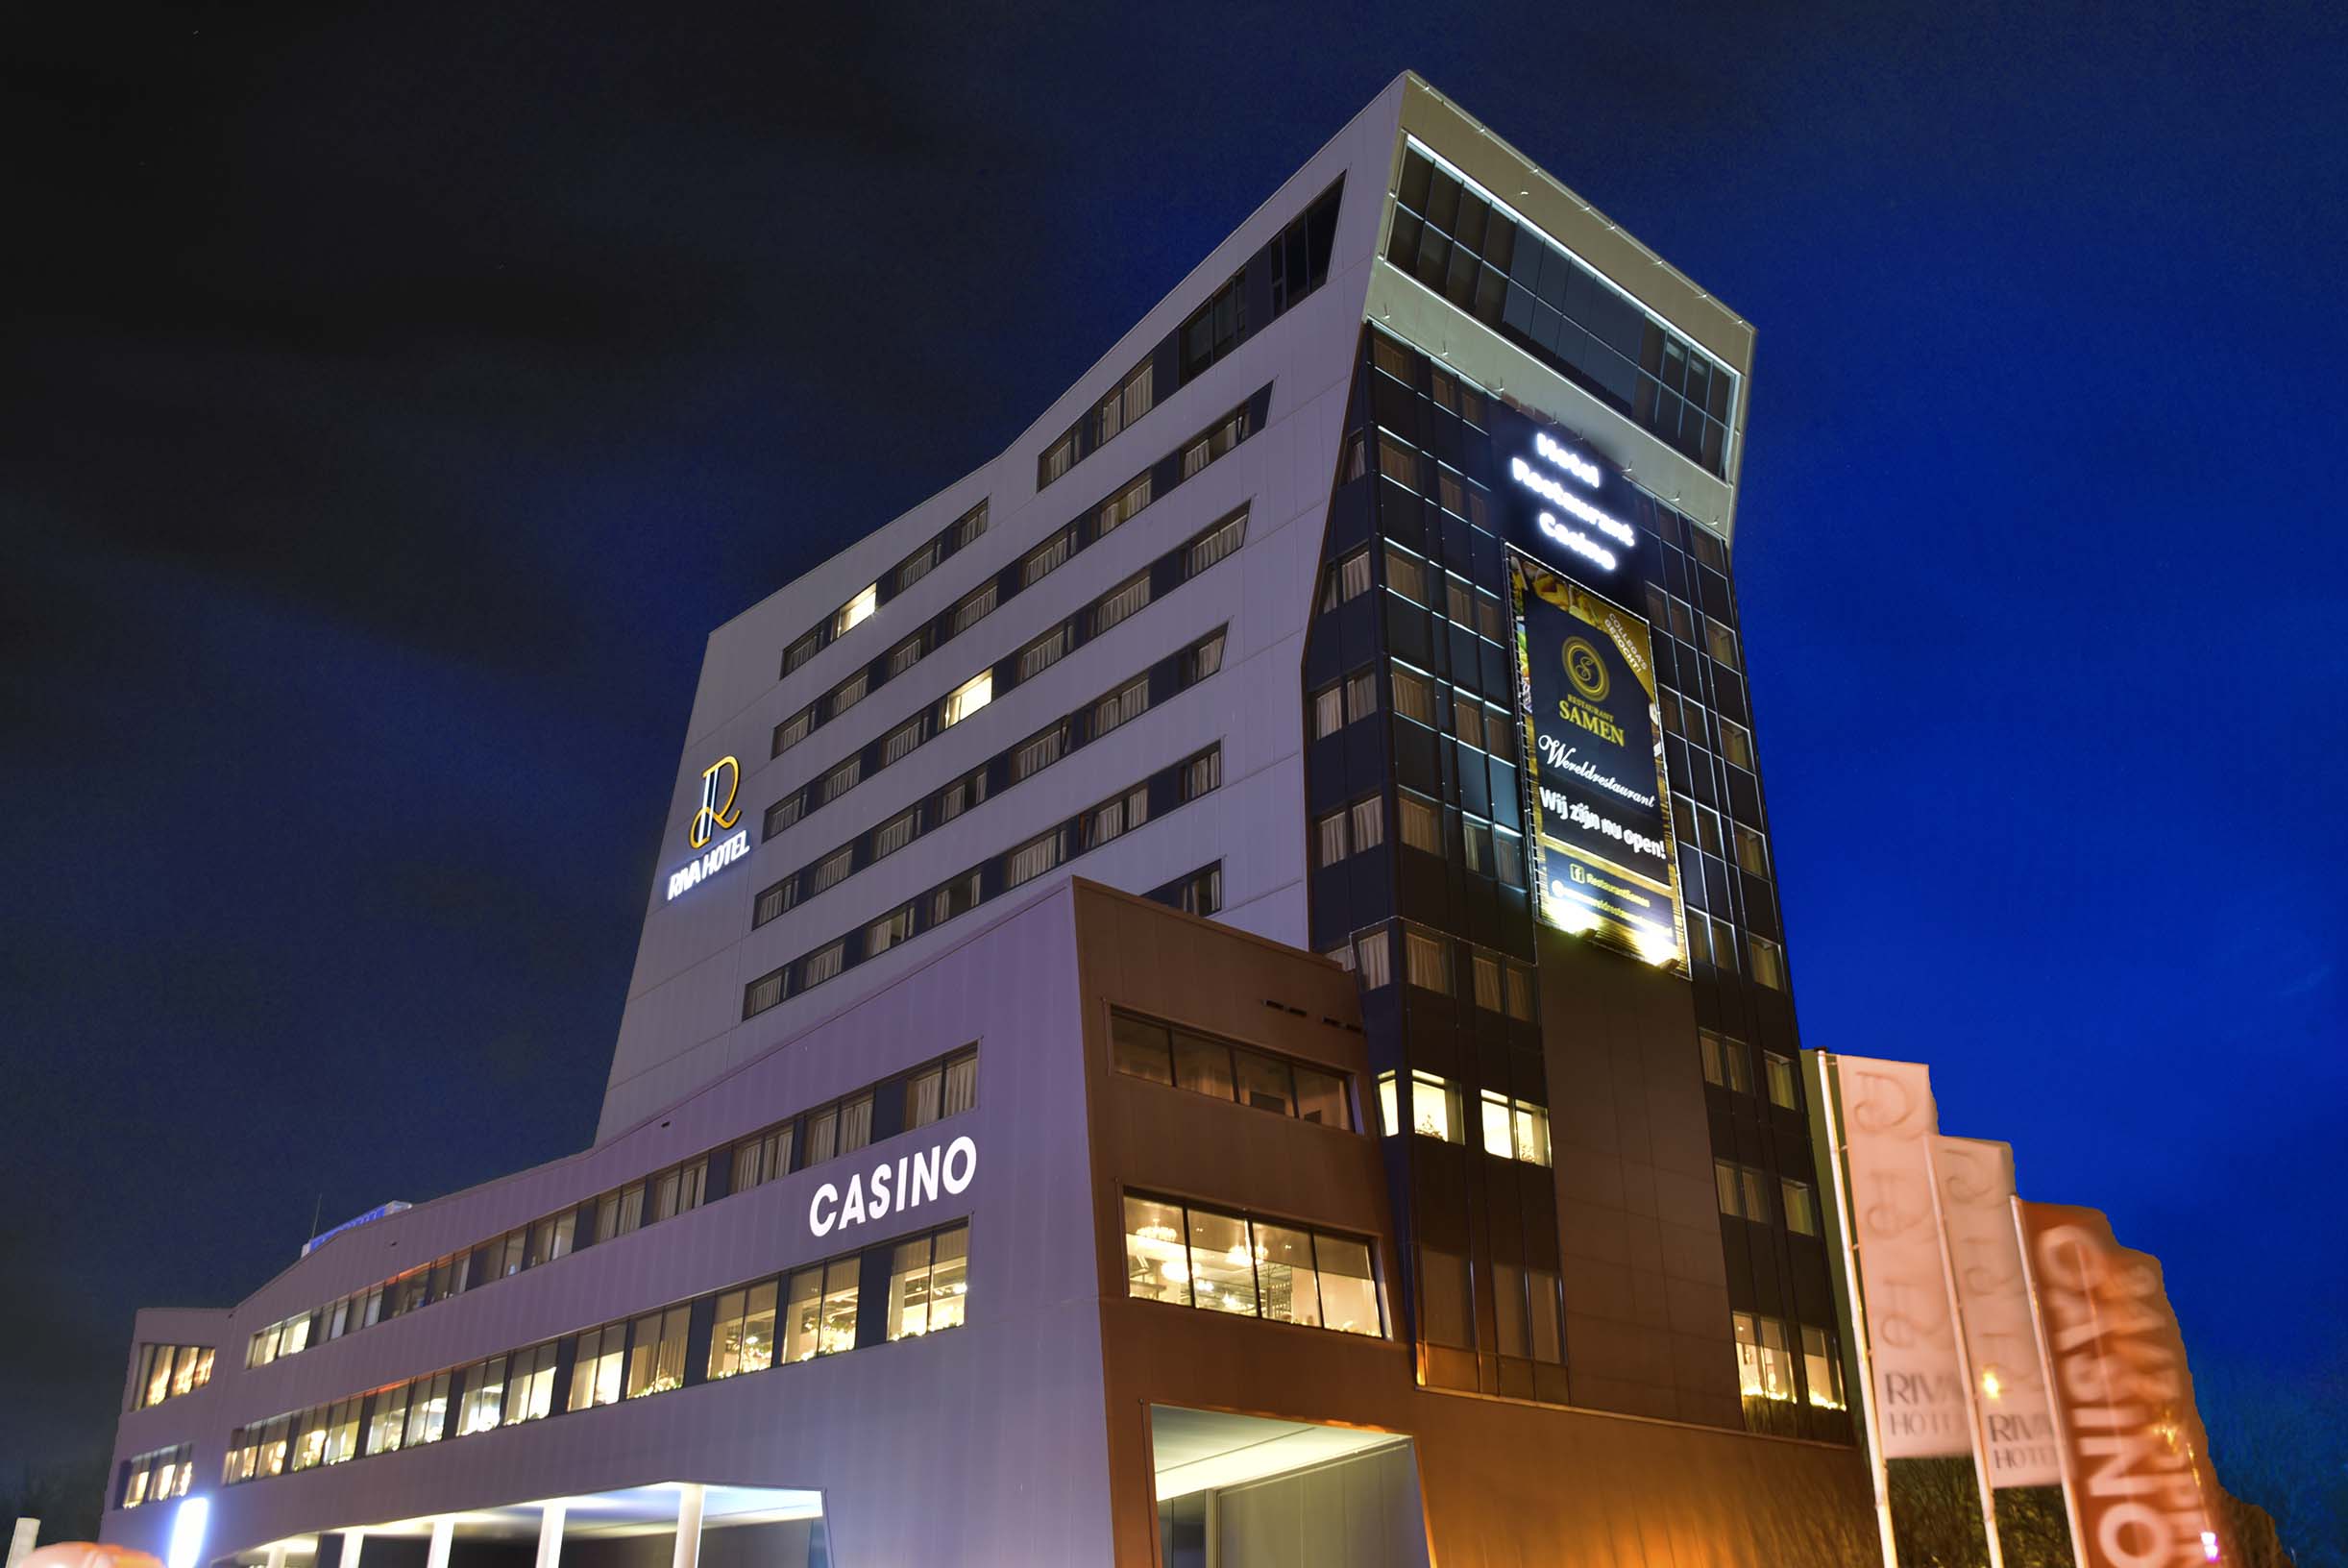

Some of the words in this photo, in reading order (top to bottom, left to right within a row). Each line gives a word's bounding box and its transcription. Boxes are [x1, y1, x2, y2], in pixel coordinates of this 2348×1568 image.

[1539, 512, 1616, 570] Casino
[1558, 699, 1626, 747] SAMEN
[1538, 734, 1656, 808] Wereldrestaurant
[1539, 787, 1569, 820] Wij
[1569, 802, 1601, 829] zijn
[1601, 818, 1623, 841] nu
[1623, 829, 1667, 860] open!
[667, 859, 702, 901] RIVA
[701, 829, 751, 880] HOTEL
[809, 1136, 977, 1237] CASINO
[1885, 1373, 1964, 1406] RIV
[2037, 1224, 2173, 1568] CASINO
